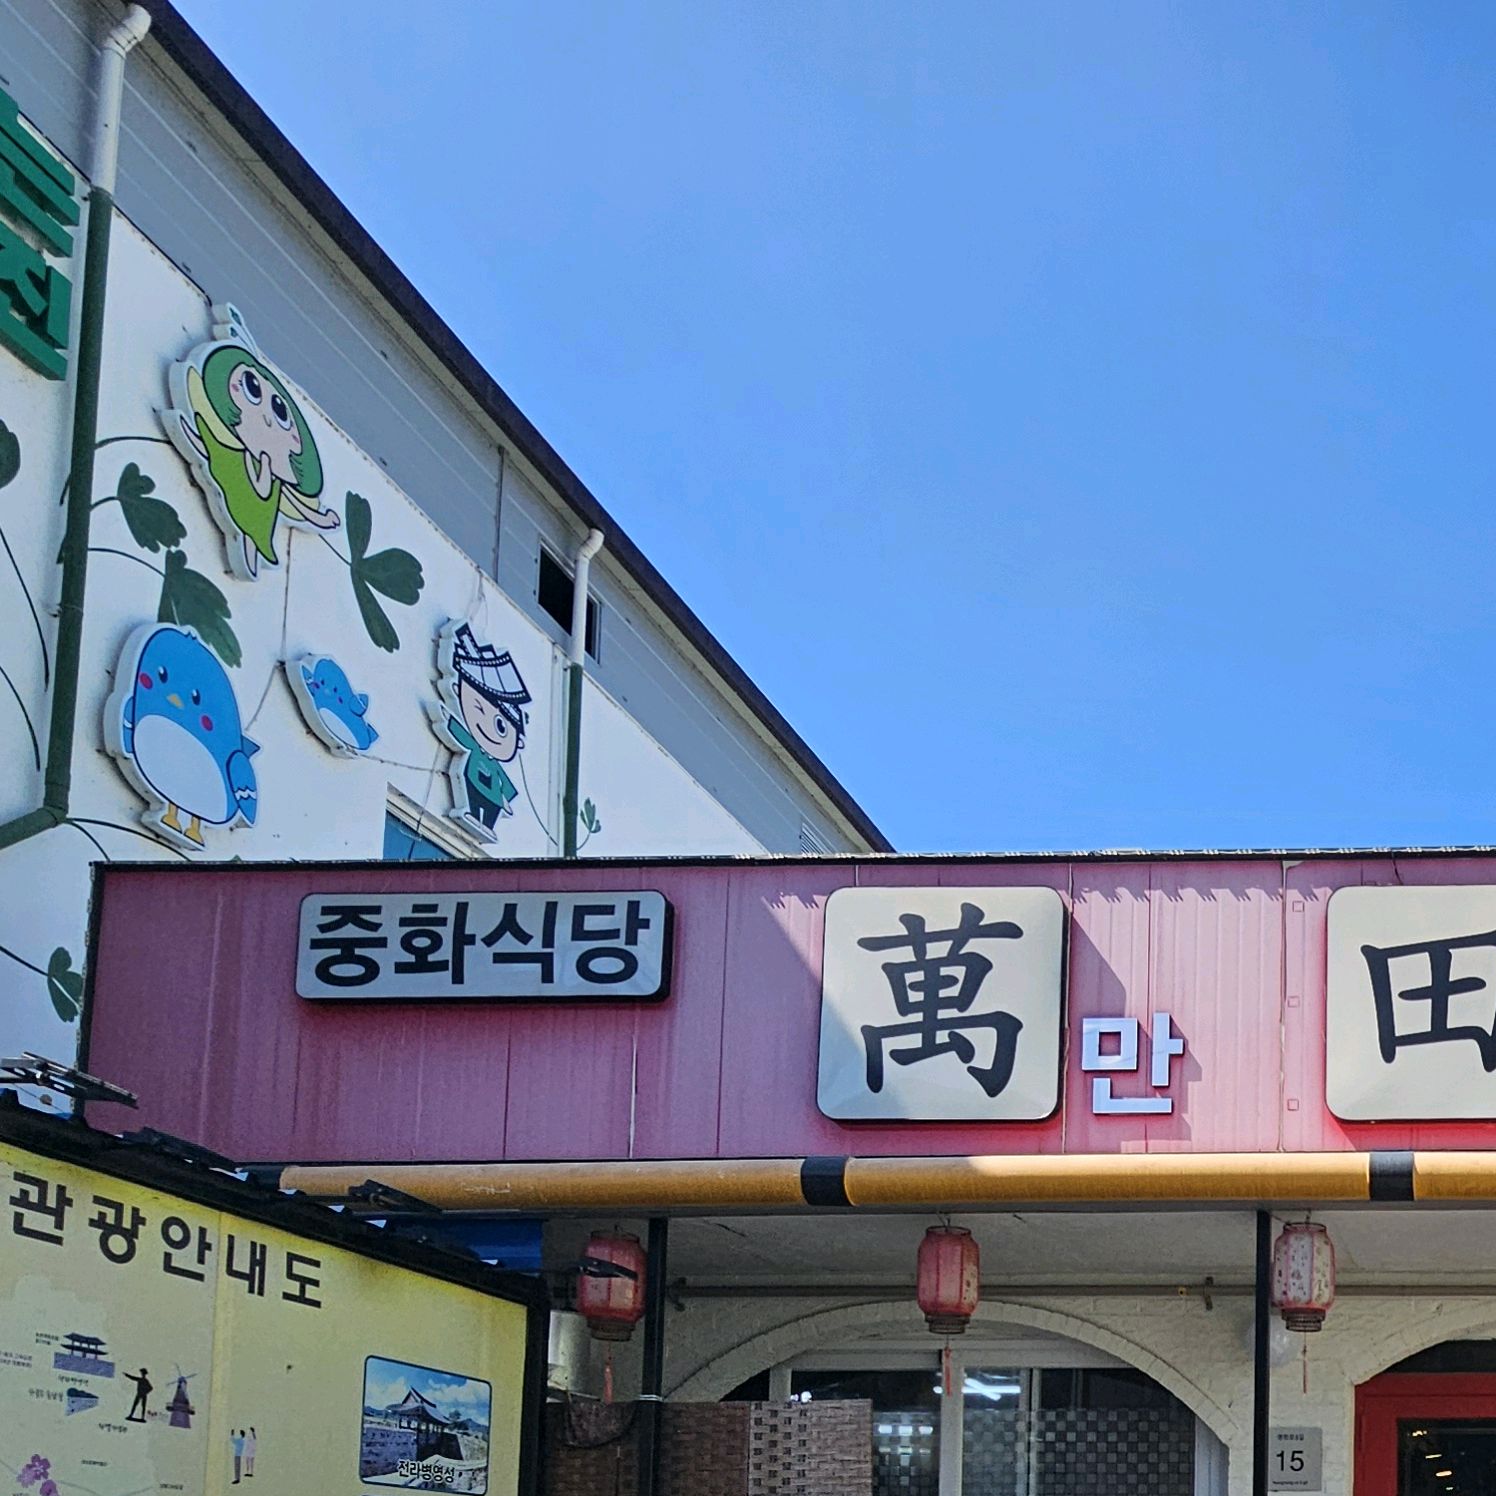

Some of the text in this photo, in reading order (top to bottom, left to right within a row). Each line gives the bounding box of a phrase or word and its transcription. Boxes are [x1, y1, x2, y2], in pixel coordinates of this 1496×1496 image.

[308, 901, 651, 987] 중화식당
[858, 902, 1024, 1100] 萬
[1081, 1012, 1186, 1115] 만
[9, 1171, 322, 1309] 관광안내도
[397, 1459, 456, 1484] 전라병영성
[1276, 1450, 1305, 1472] 15
